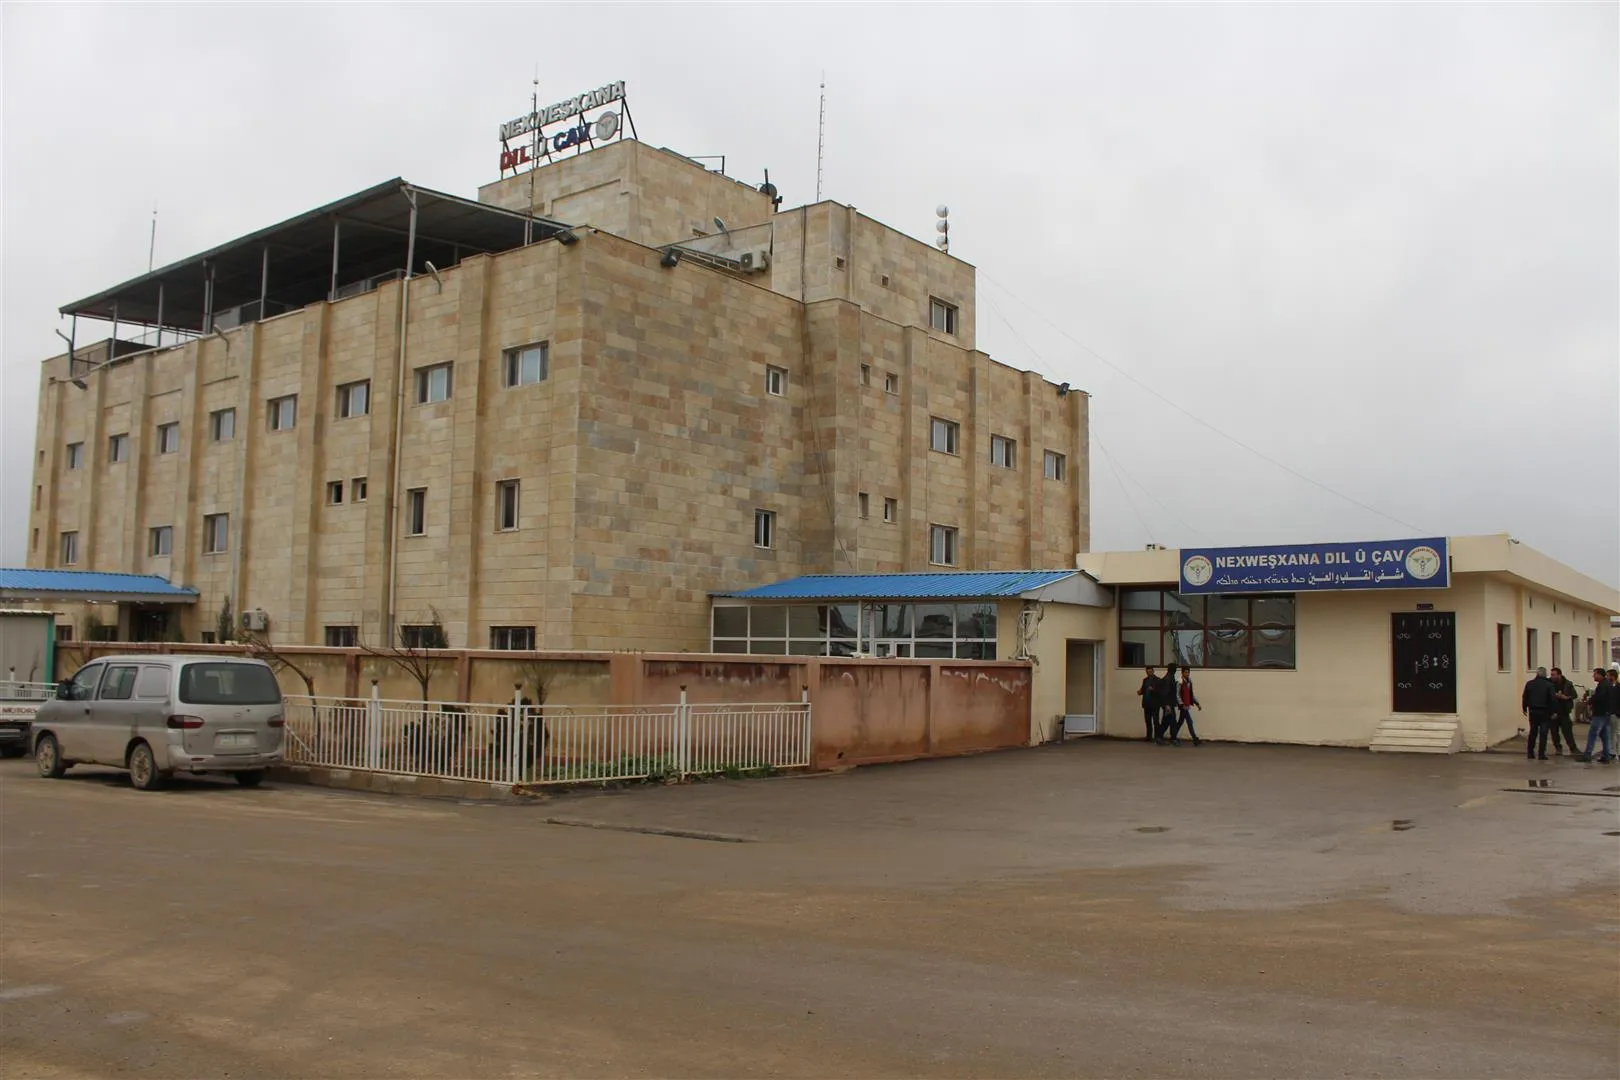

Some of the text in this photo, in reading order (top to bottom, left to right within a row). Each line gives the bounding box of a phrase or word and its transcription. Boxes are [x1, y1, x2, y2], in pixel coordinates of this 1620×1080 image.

[500, 146, 531, 170] DIL
[1216, 552, 1320, 569] NEXWEŞXANA
[1324, 551, 1350, 564] DIL
[1355, 548, 1366, 563] Û
[1371, 549, 1405, 566] ÇAV
